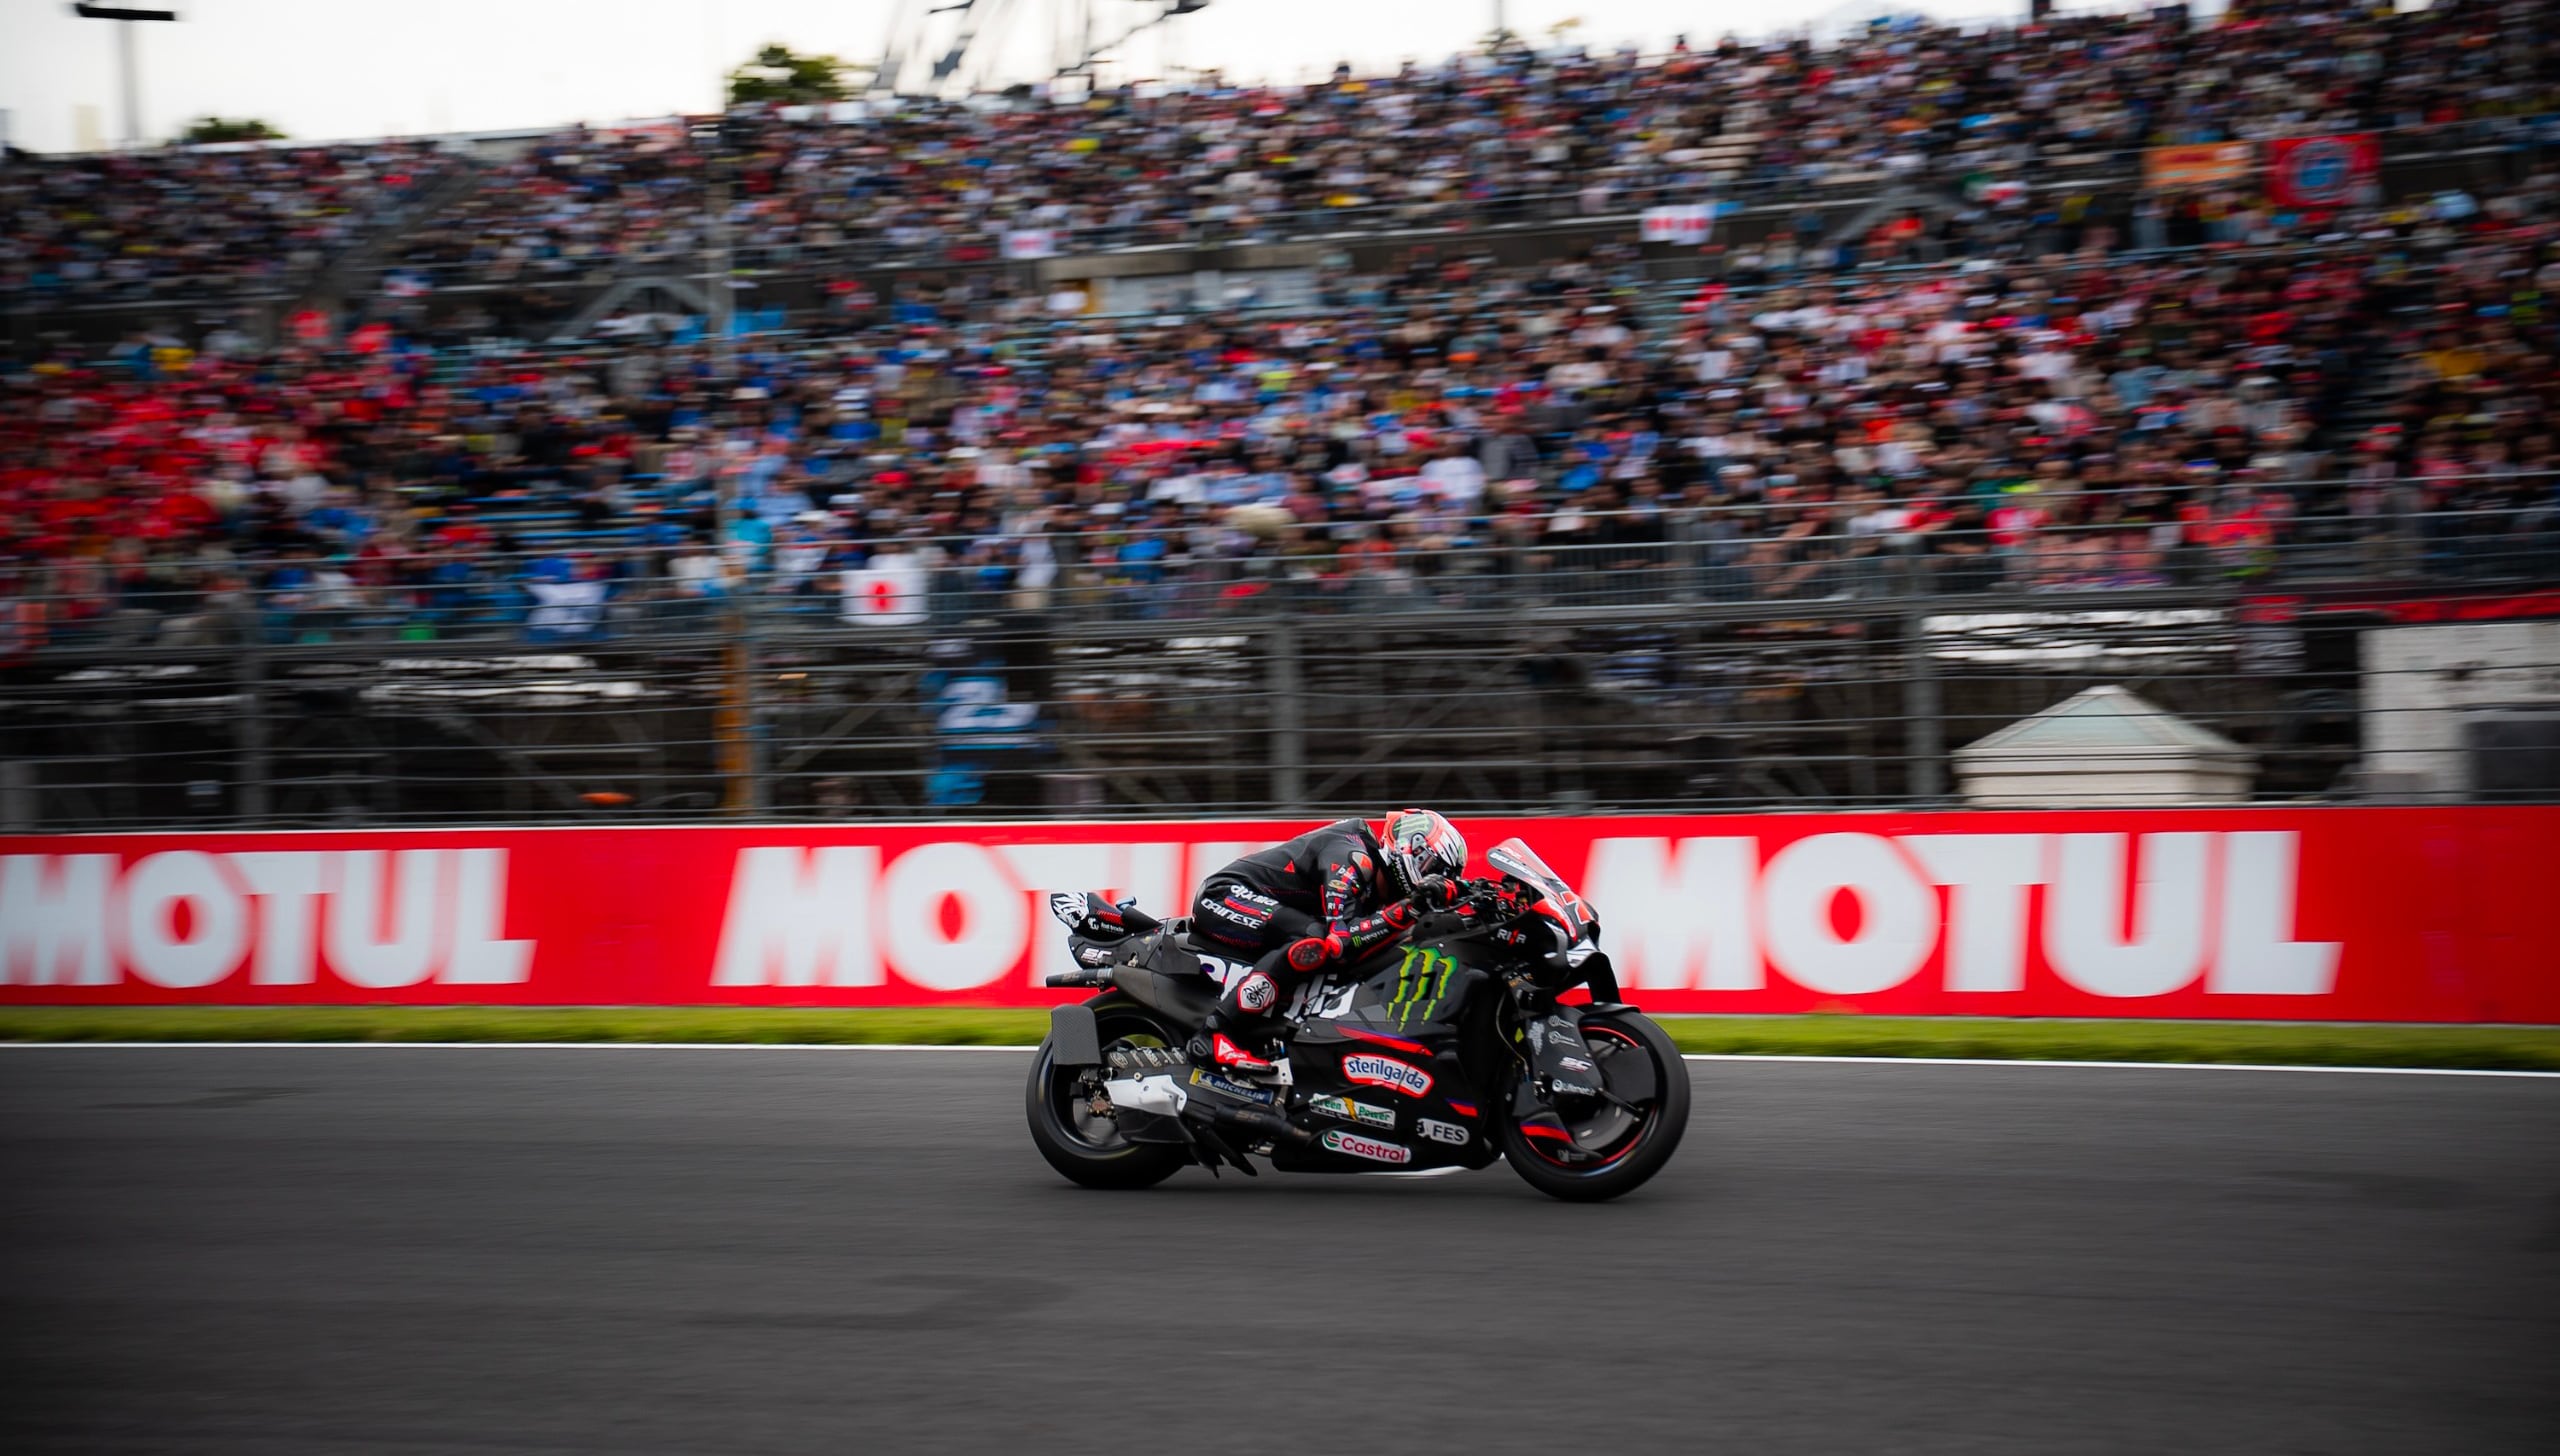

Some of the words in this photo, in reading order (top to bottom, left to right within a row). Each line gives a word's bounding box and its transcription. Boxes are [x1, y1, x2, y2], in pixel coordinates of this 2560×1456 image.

[0, 849, 536, 989] MOTUL
[1200, 898, 1263, 929] DAINESE
[1575, 831, 2343, 997] MOTUL
[1348, 1057, 1425, 1089] sterilgarda
[1214, 1080, 1265, 1100] MICHELIN
[1359, 1106, 1390, 1121] Power
[1433, 1124, 1465, 1142] FES
[1341, 1137, 1405, 1162] Castrol
